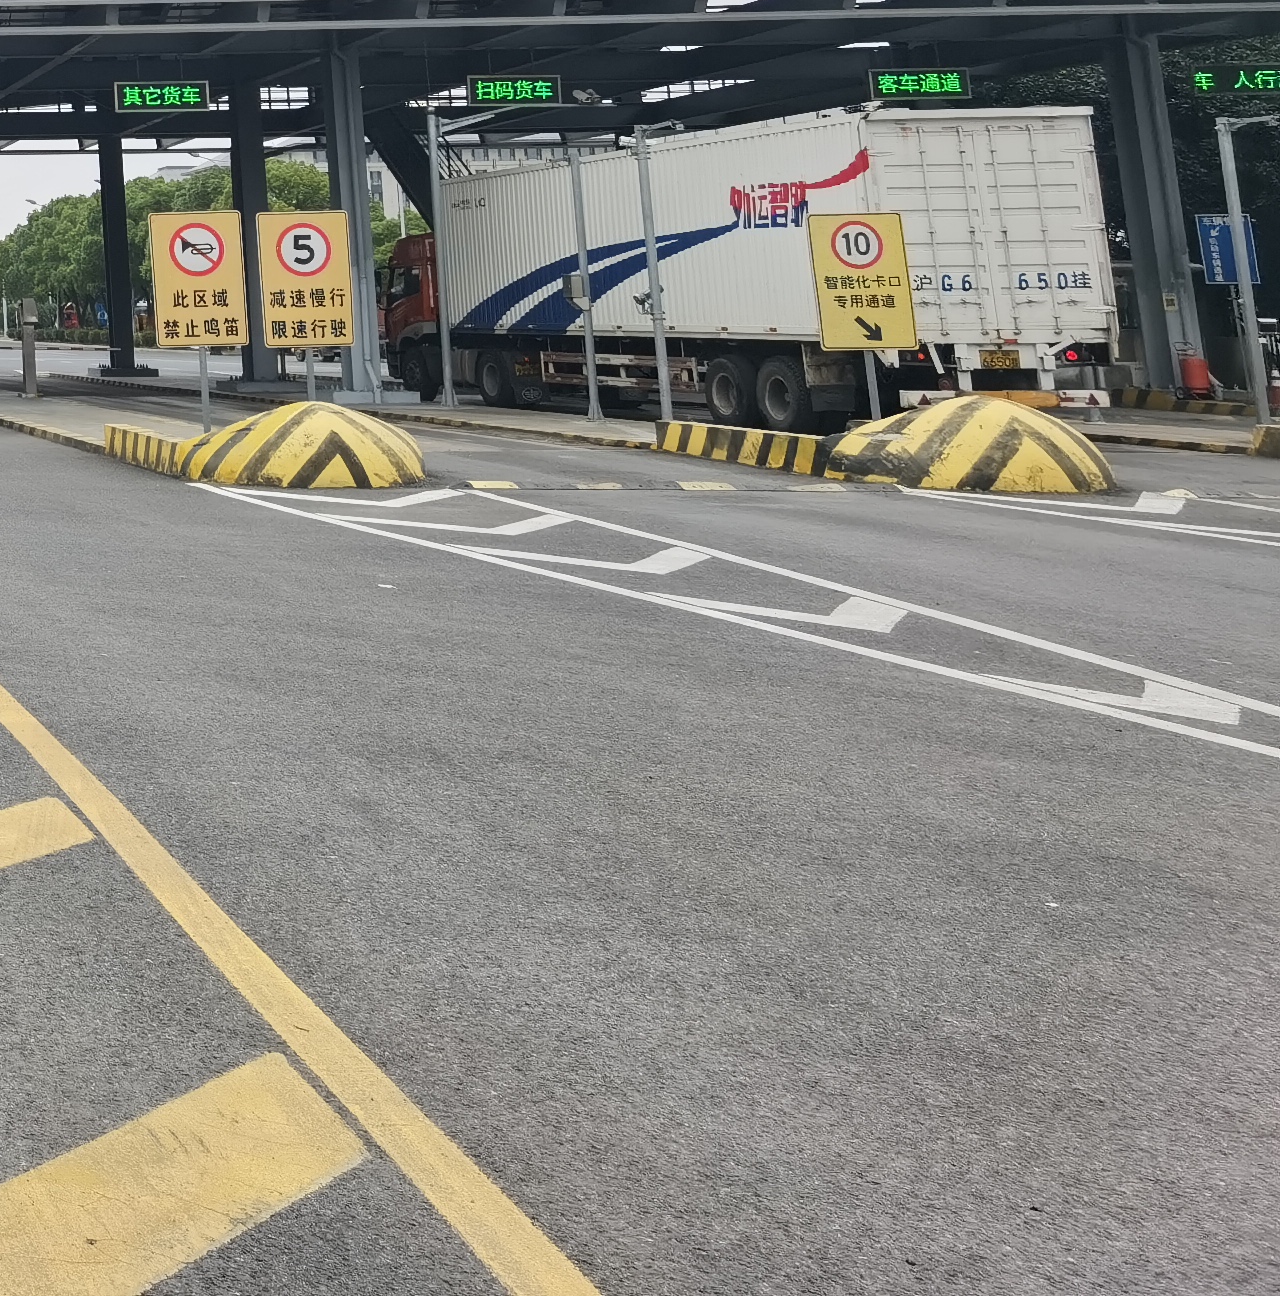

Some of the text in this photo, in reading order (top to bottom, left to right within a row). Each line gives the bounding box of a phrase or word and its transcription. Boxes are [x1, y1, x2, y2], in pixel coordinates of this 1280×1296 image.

[476, 80, 553, 99] 扫码货车
[878, 73, 962, 93] 客车通道
[1194, 71, 1280, 91] 车 人行
[123, 86, 201, 105] 其它货车
[293, 234, 316, 265] 5
[840, 232, 871, 257] 10
[823, 274, 902, 291] 智能化卡口
[172, 289, 229, 309] 此区域
[269, 287, 346, 309] 减速慢行
[833, 293, 897, 310] 专用通道
[163, 317, 240, 339] 禁止鸣笛
[271, 318, 347, 339] 限速行驶
